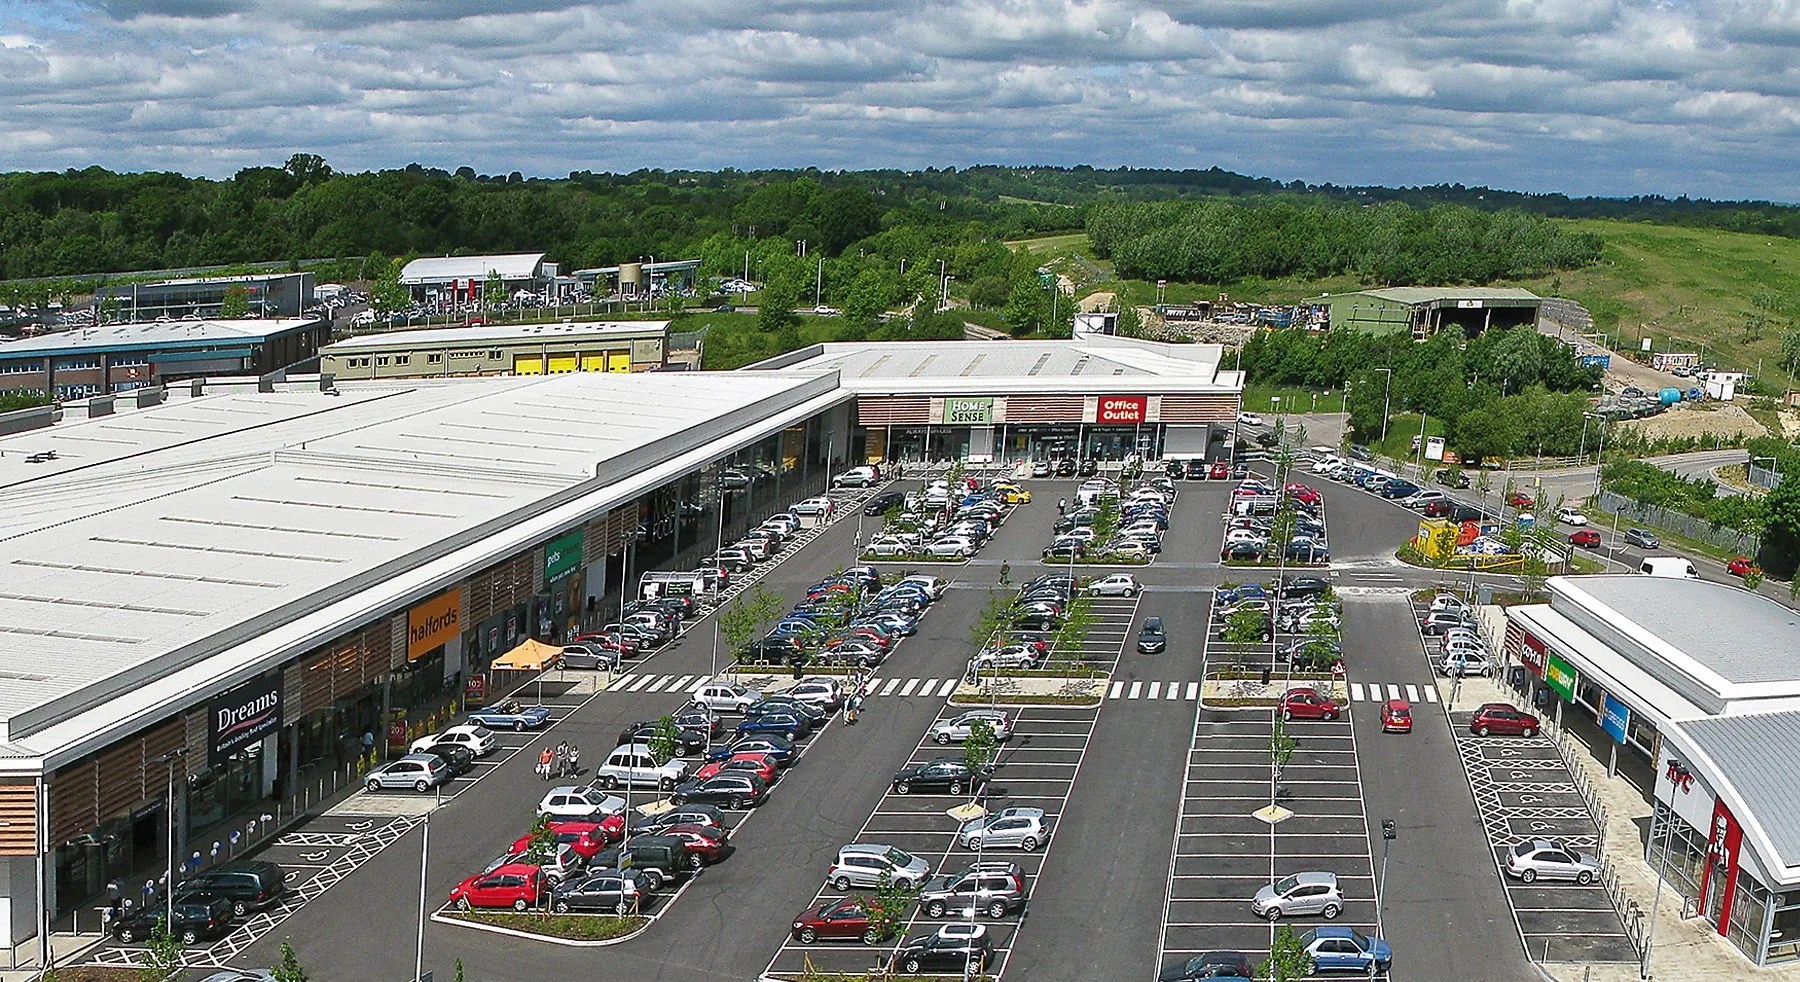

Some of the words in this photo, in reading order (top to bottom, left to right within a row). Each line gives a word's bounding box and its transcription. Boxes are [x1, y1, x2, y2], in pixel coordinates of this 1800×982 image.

[952, 400, 985, 411] HOME
[1104, 400, 1139, 410] Office
[951, 411, 984, 422] SENSE
[1103, 410, 1139, 420] Outlet
[410, 607, 458, 645] halfords
[1548, 664, 1574, 690] SUBWAY
[217, 690, 278, 732] Dreams
